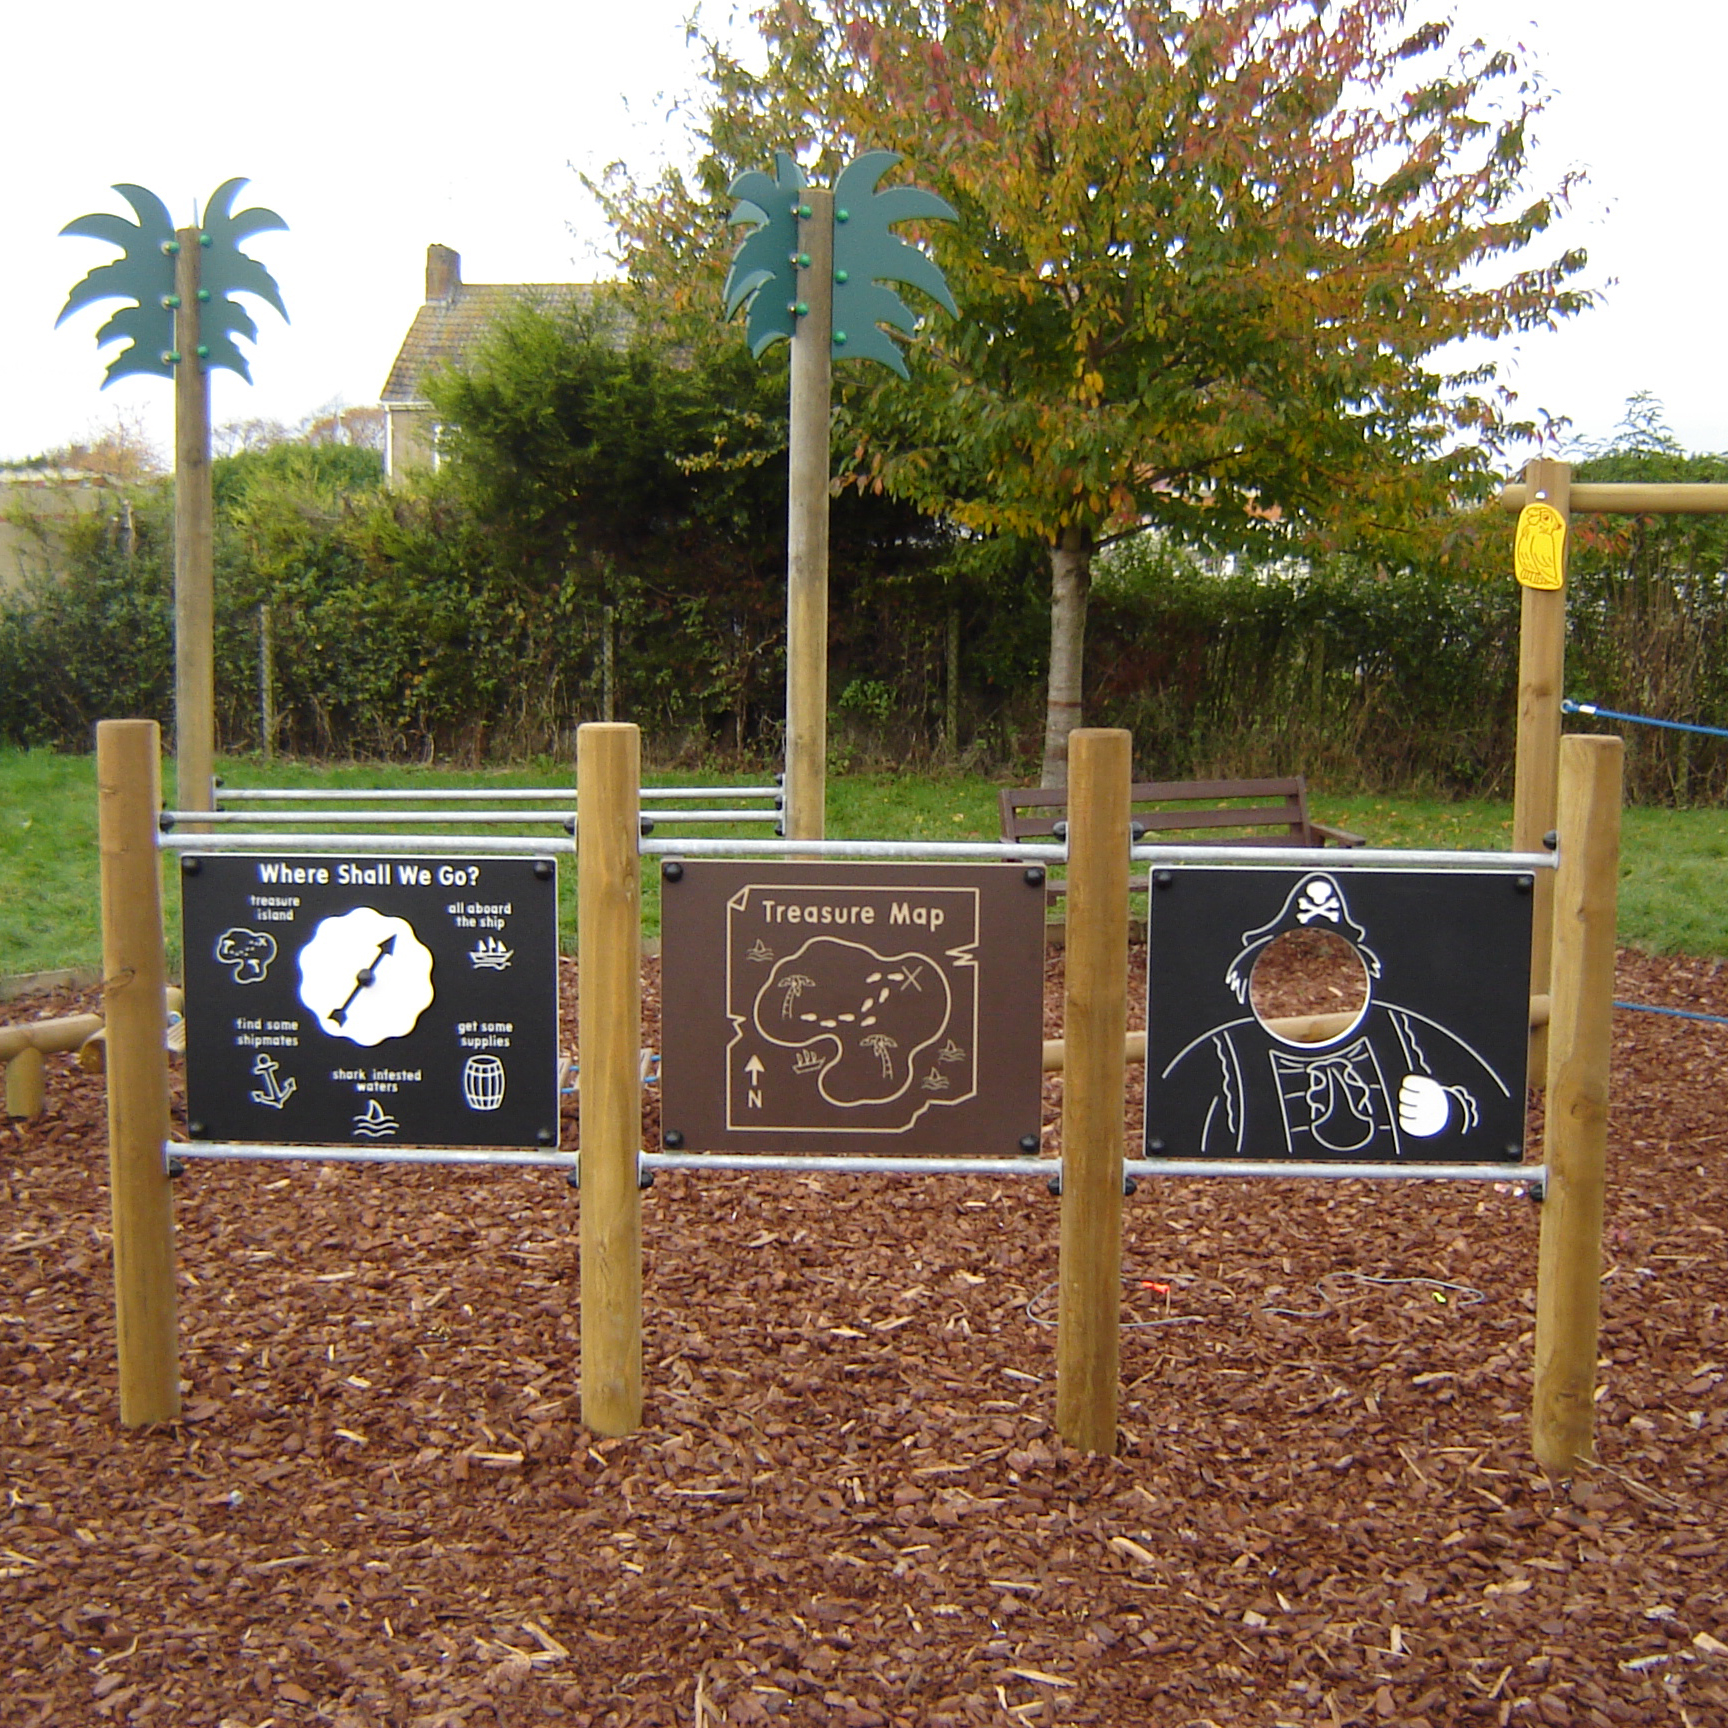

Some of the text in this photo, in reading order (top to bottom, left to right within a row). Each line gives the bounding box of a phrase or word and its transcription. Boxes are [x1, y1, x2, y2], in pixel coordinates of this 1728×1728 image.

[260, 863, 479, 885] Where Shall We Go?
[251, 895, 300, 906] treasure
[258, 909, 293, 920] island
[448, 902, 511, 914] all aboard
[456, 916, 504, 930] the ship
[762, 901, 944, 932] Treasure Map
[237, 1018, 298, 1030] find some
[458, 1021, 512, 1034] get some
[238, 1034, 298, 1048] shipmates
[461, 1035, 510, 1049] supplies
[333, 1069, 421, 1080] shark infested
[357, 1082, 397, 1092] waters
[749, 1090, 761, 1108] N
